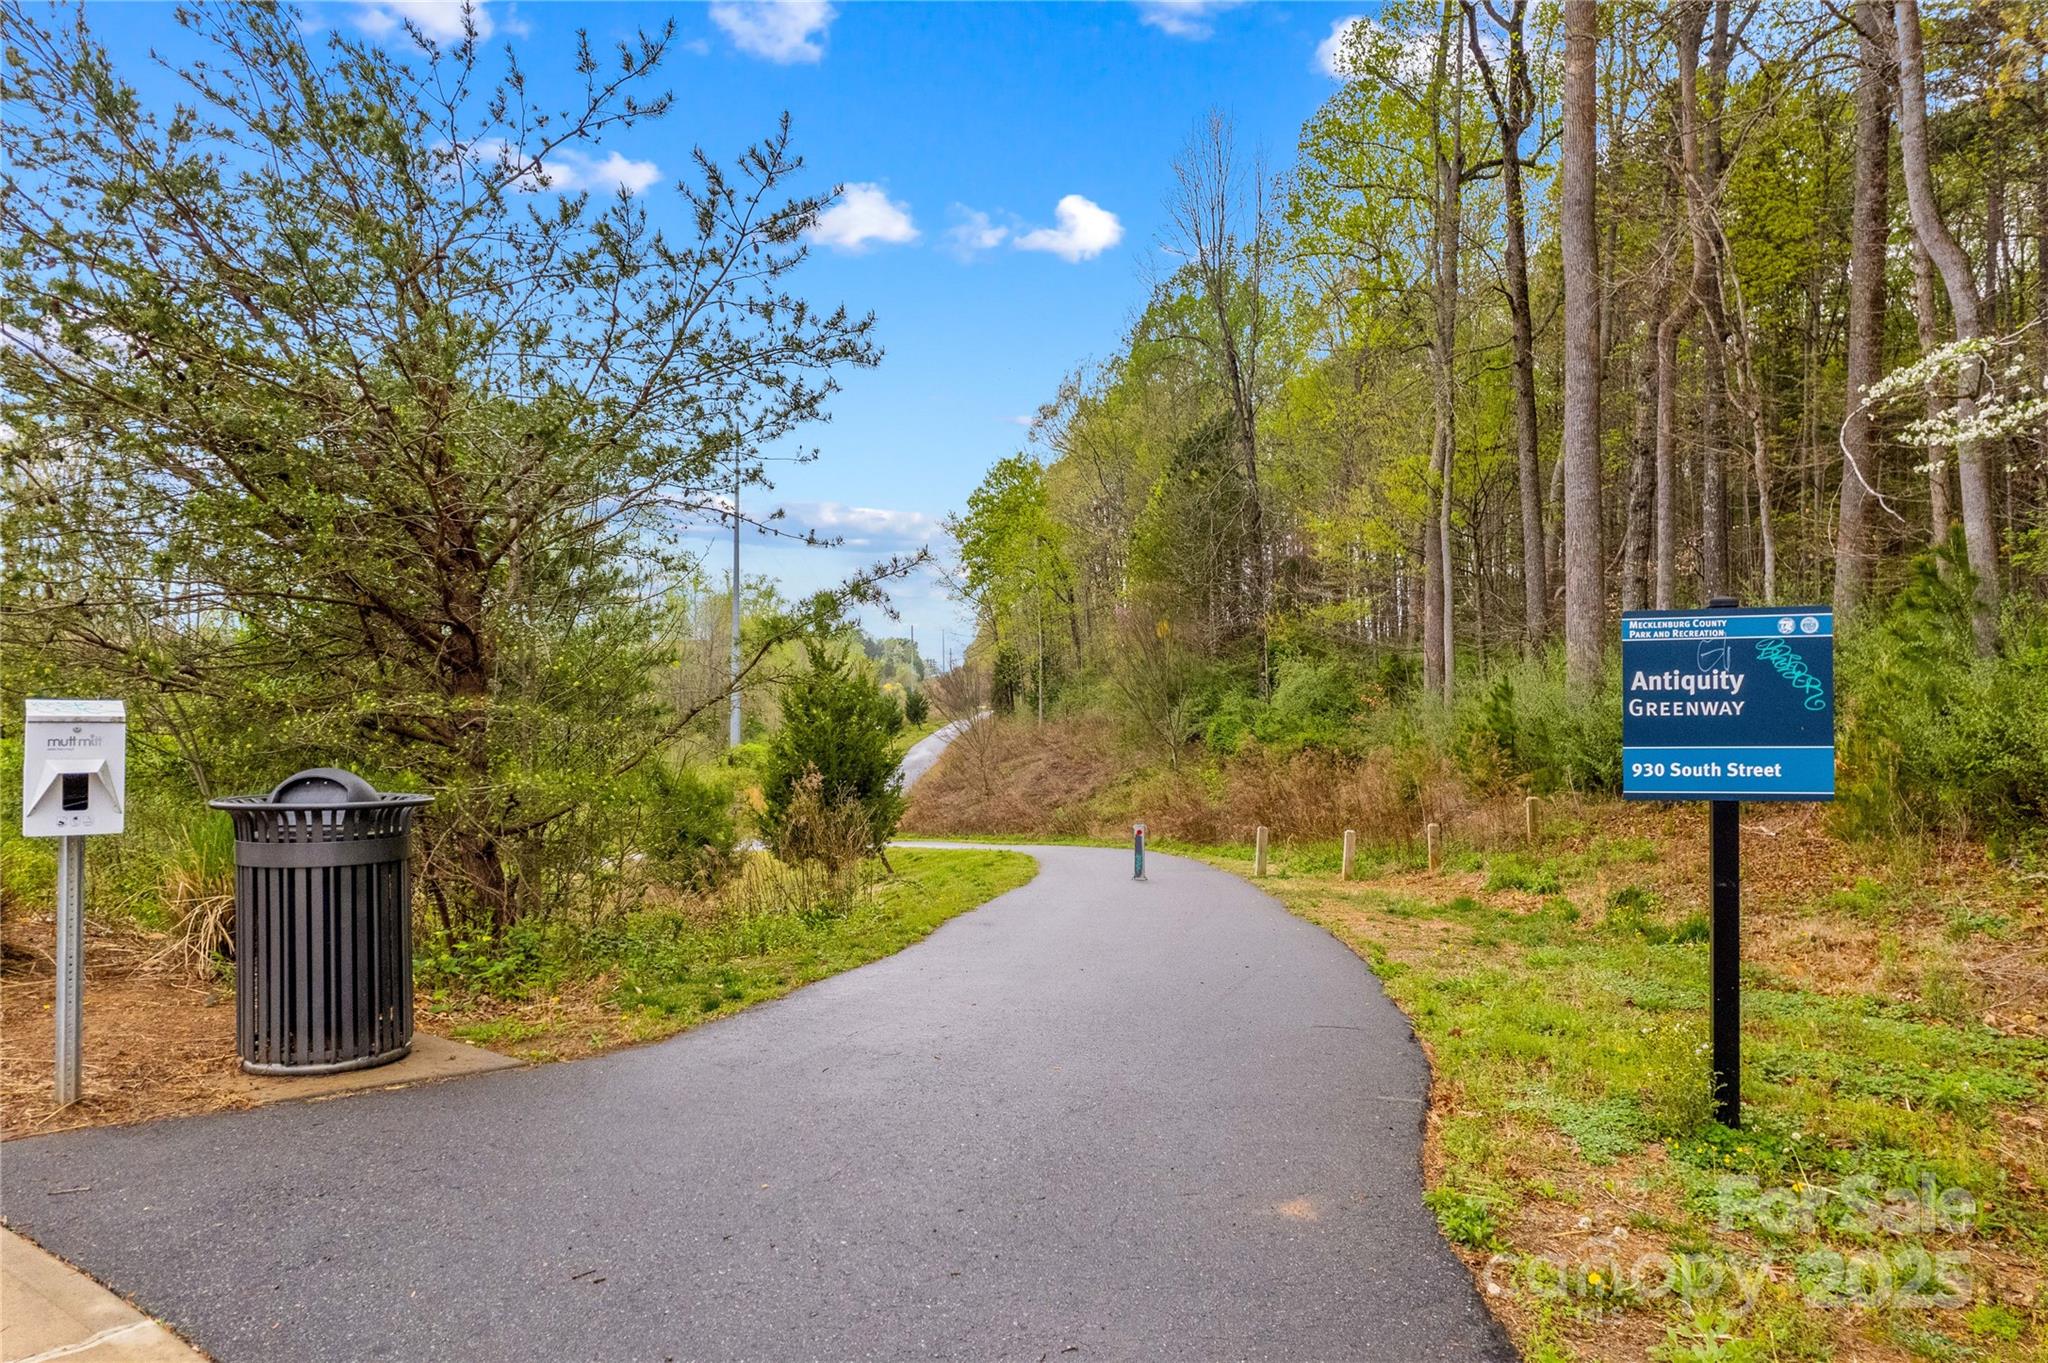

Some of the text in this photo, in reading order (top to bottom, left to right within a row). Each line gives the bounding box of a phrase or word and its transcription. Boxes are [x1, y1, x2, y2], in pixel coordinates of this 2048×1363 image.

[1630, 670, 1745, 695] Antiquity
[1629, 698, 1745, 717] GREENWAY
[47, 735, 76, 747] mutt
[1632, 762, 1782, 778] 930 South Street
